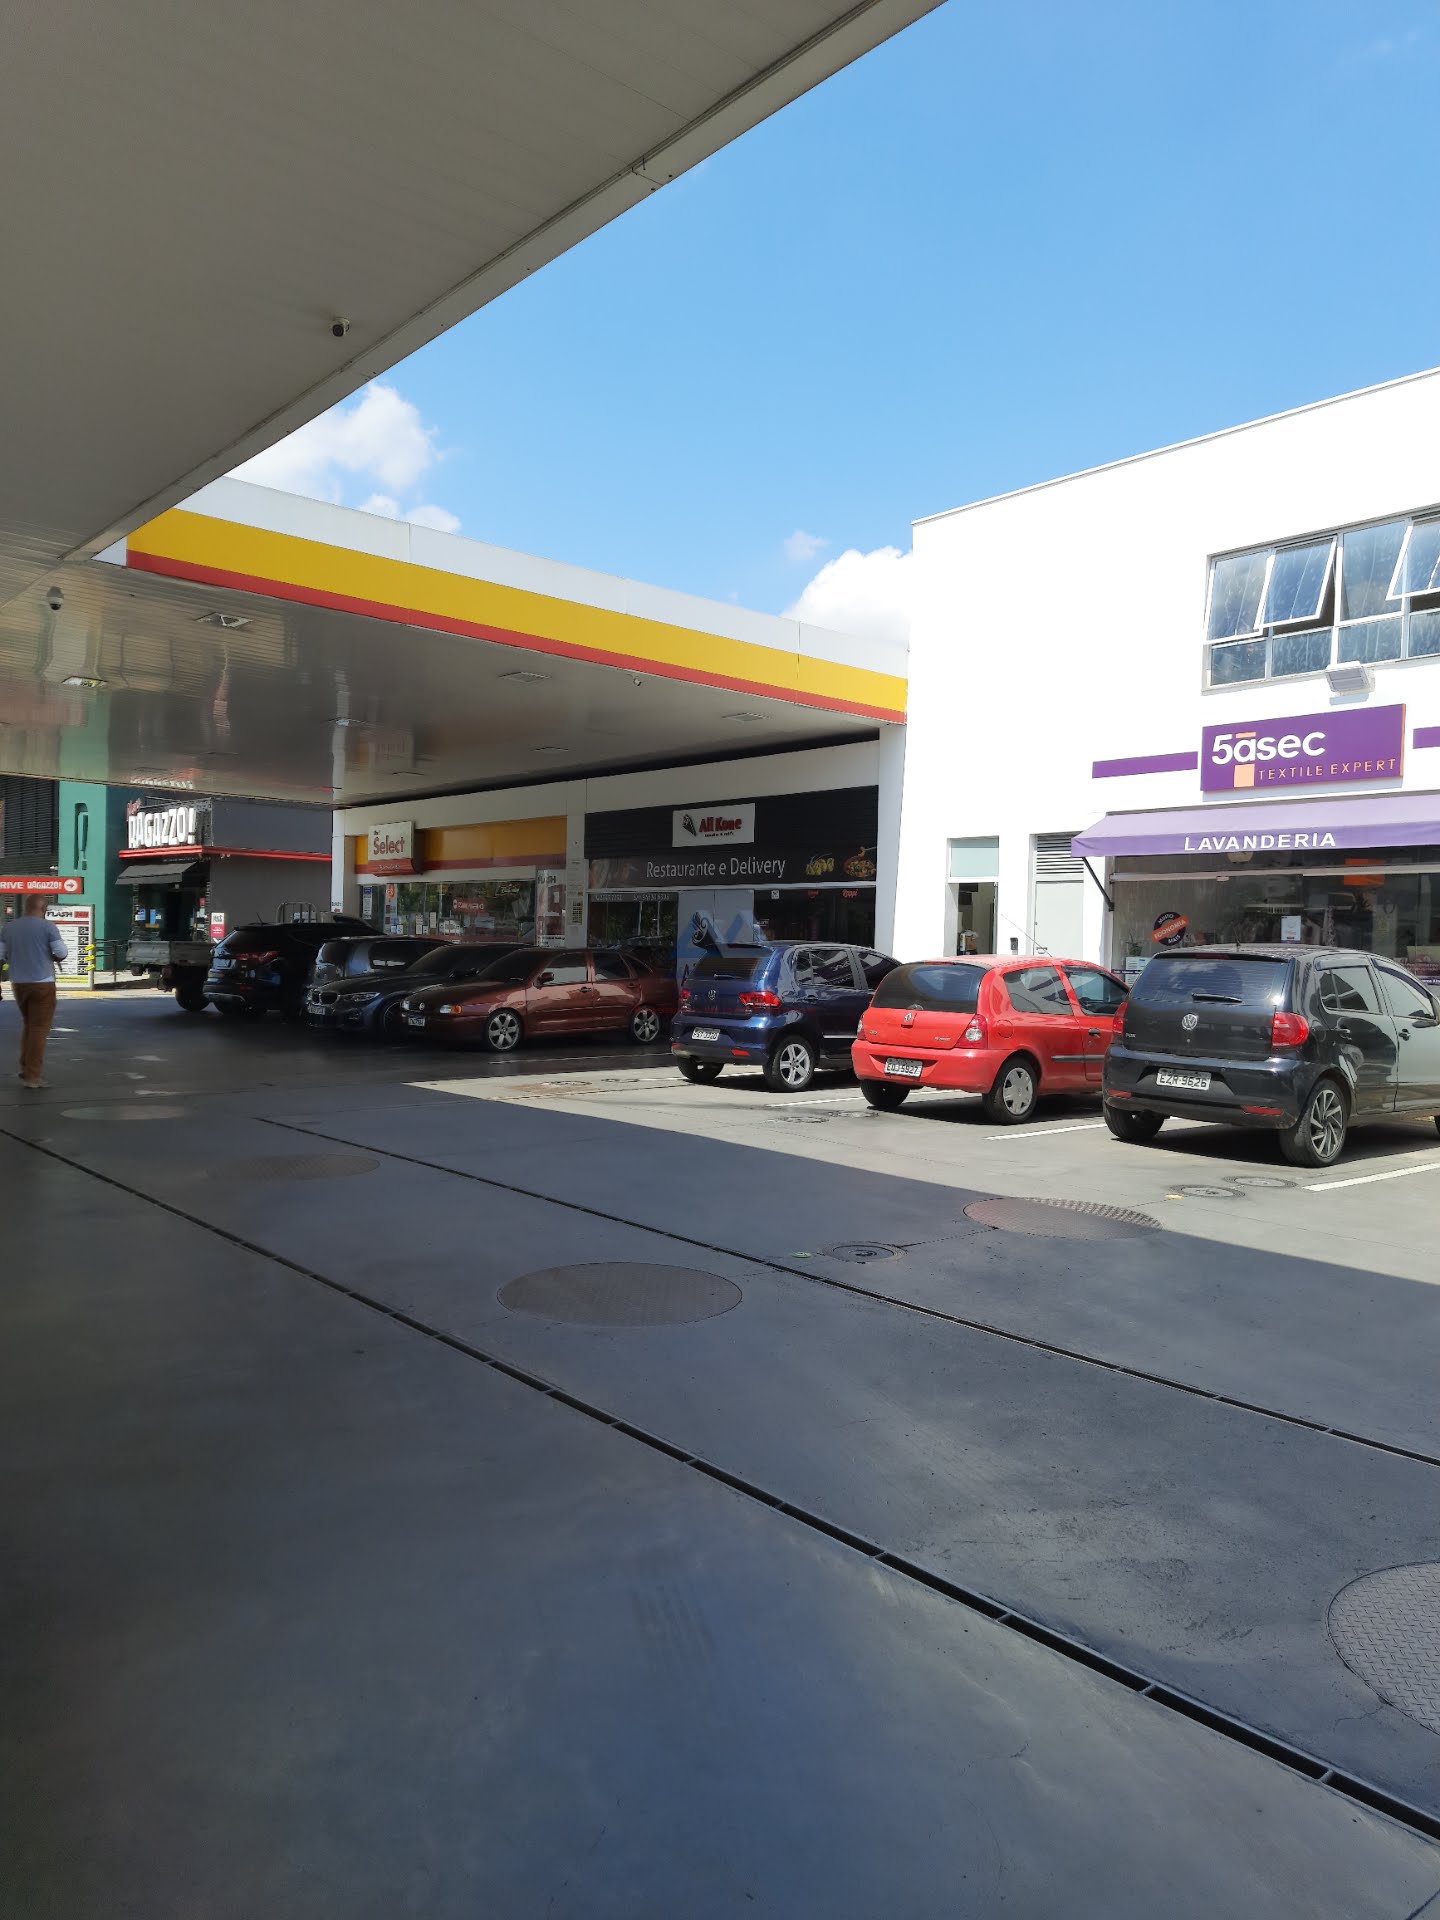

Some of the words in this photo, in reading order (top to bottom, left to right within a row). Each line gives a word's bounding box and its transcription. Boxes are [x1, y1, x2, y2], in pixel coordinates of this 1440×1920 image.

[1259, 765, 1323, 781] TEXTILE
[1330, 758, 1396, 775] EXPERT
[128, 807, 196, 849] RAGAZZO!
[373, 835, 405, 855] Select
[1184, 832, 1336, 851] LAVANDERIA
[646, 861, 715, 878] Restaurante
[718, 862, 727, 875] e
[730, 856, 786, 879] Delivery
[1154, 919, 1186, 940] ECONOMIA
